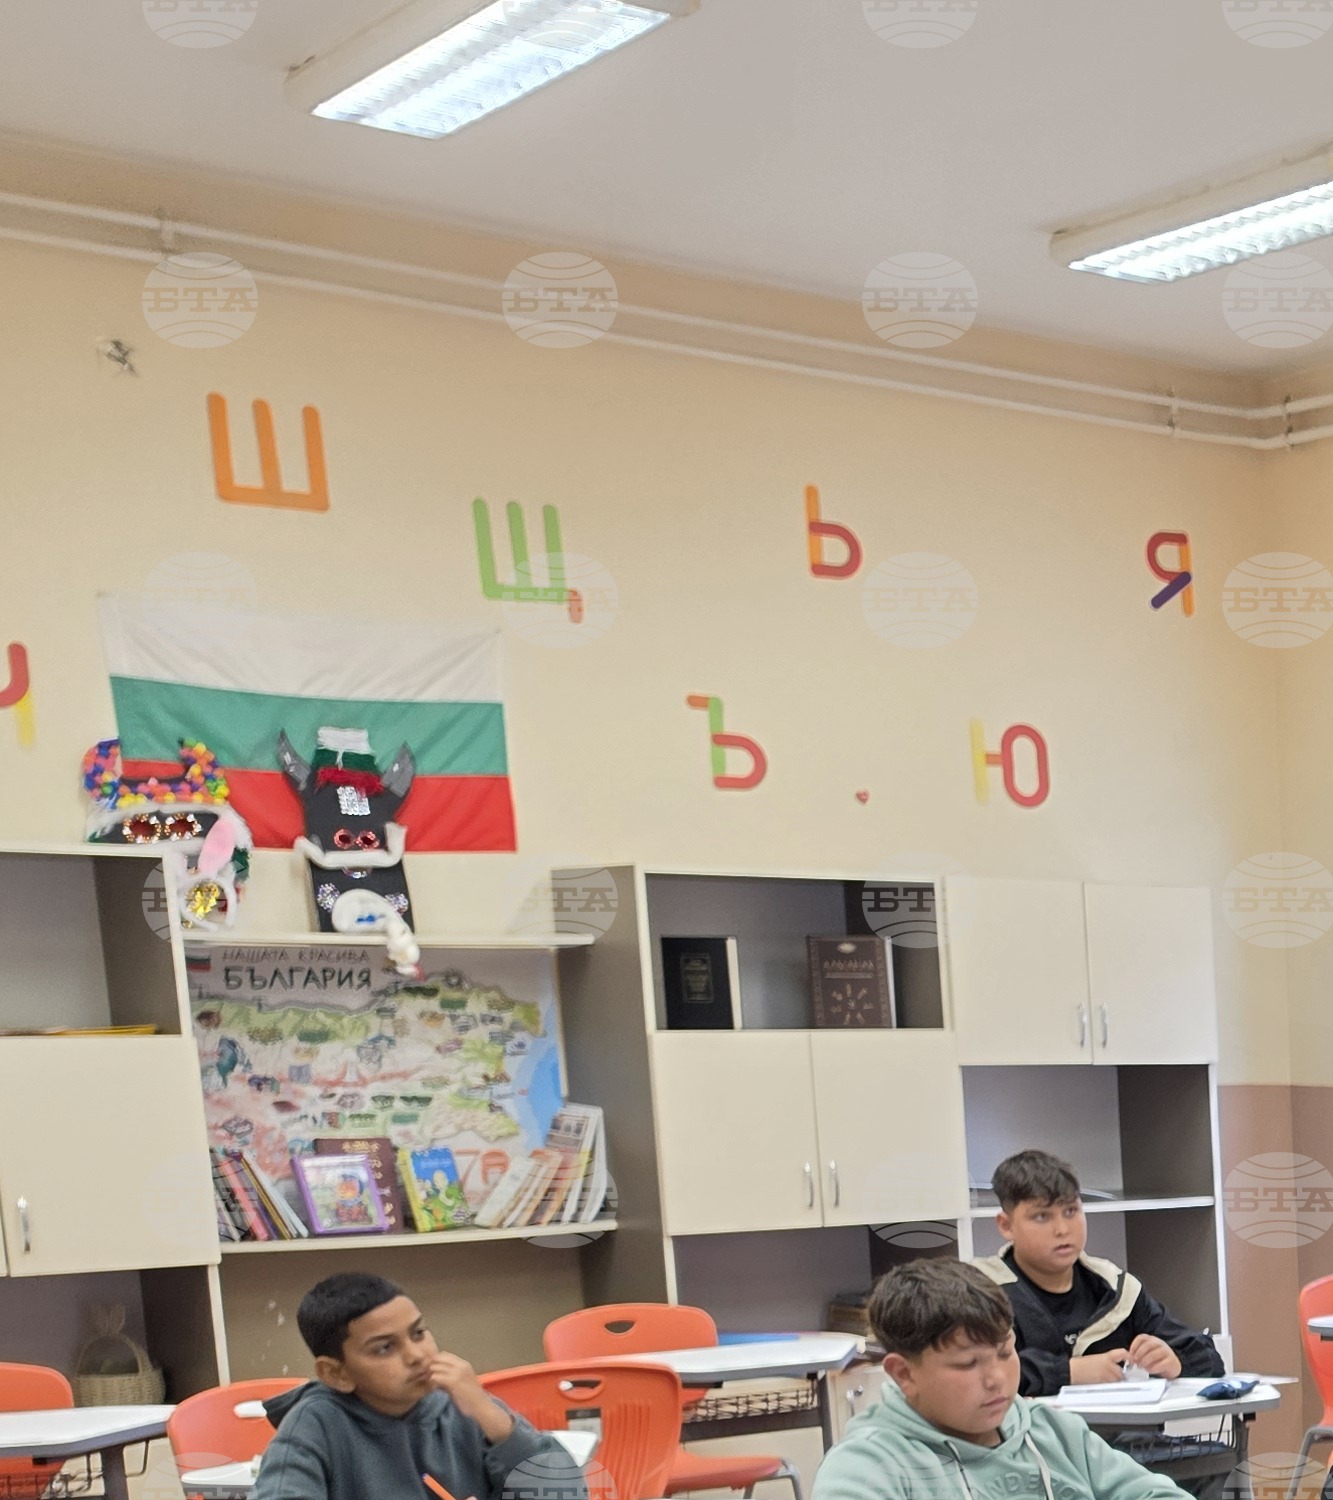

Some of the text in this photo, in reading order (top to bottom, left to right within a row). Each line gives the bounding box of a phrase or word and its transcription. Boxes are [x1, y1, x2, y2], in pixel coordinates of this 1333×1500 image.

[207, 391, 329, 512] Ш
[473, 497, 583, 623] Щ
[804, 484, 862, 579] Ь
[1146, 531, 1194, 618] Я
[686, 696, 767, 790] Ъ
[969, 717, 1050, 807] Ю
[224, 965, 371, 990] БЪЛГАРИЯ
